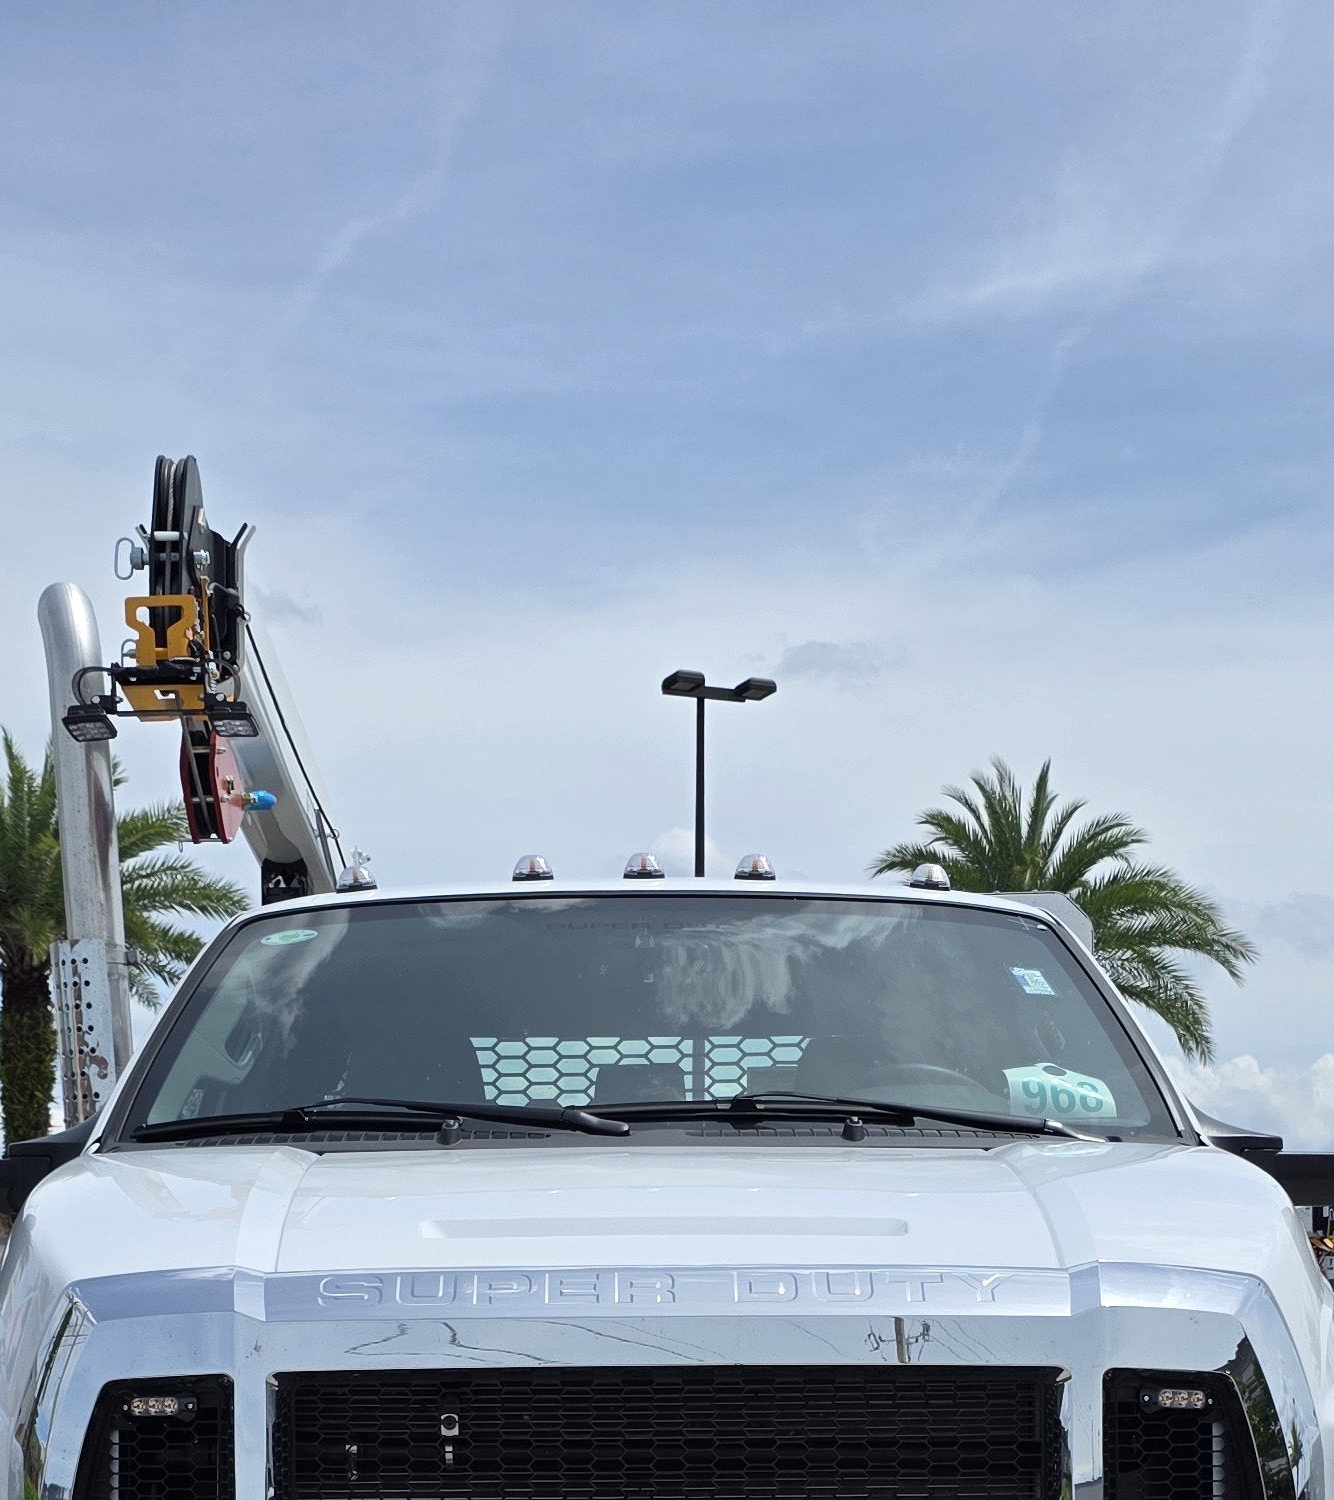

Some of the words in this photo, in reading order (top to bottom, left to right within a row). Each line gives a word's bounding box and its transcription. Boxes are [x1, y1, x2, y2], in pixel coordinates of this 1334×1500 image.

[1021, 1077, 1104, 1115] 968
[317, 1273, 676, 1306] SUPER
[733, 1272, 1013, 1303] DUTY
